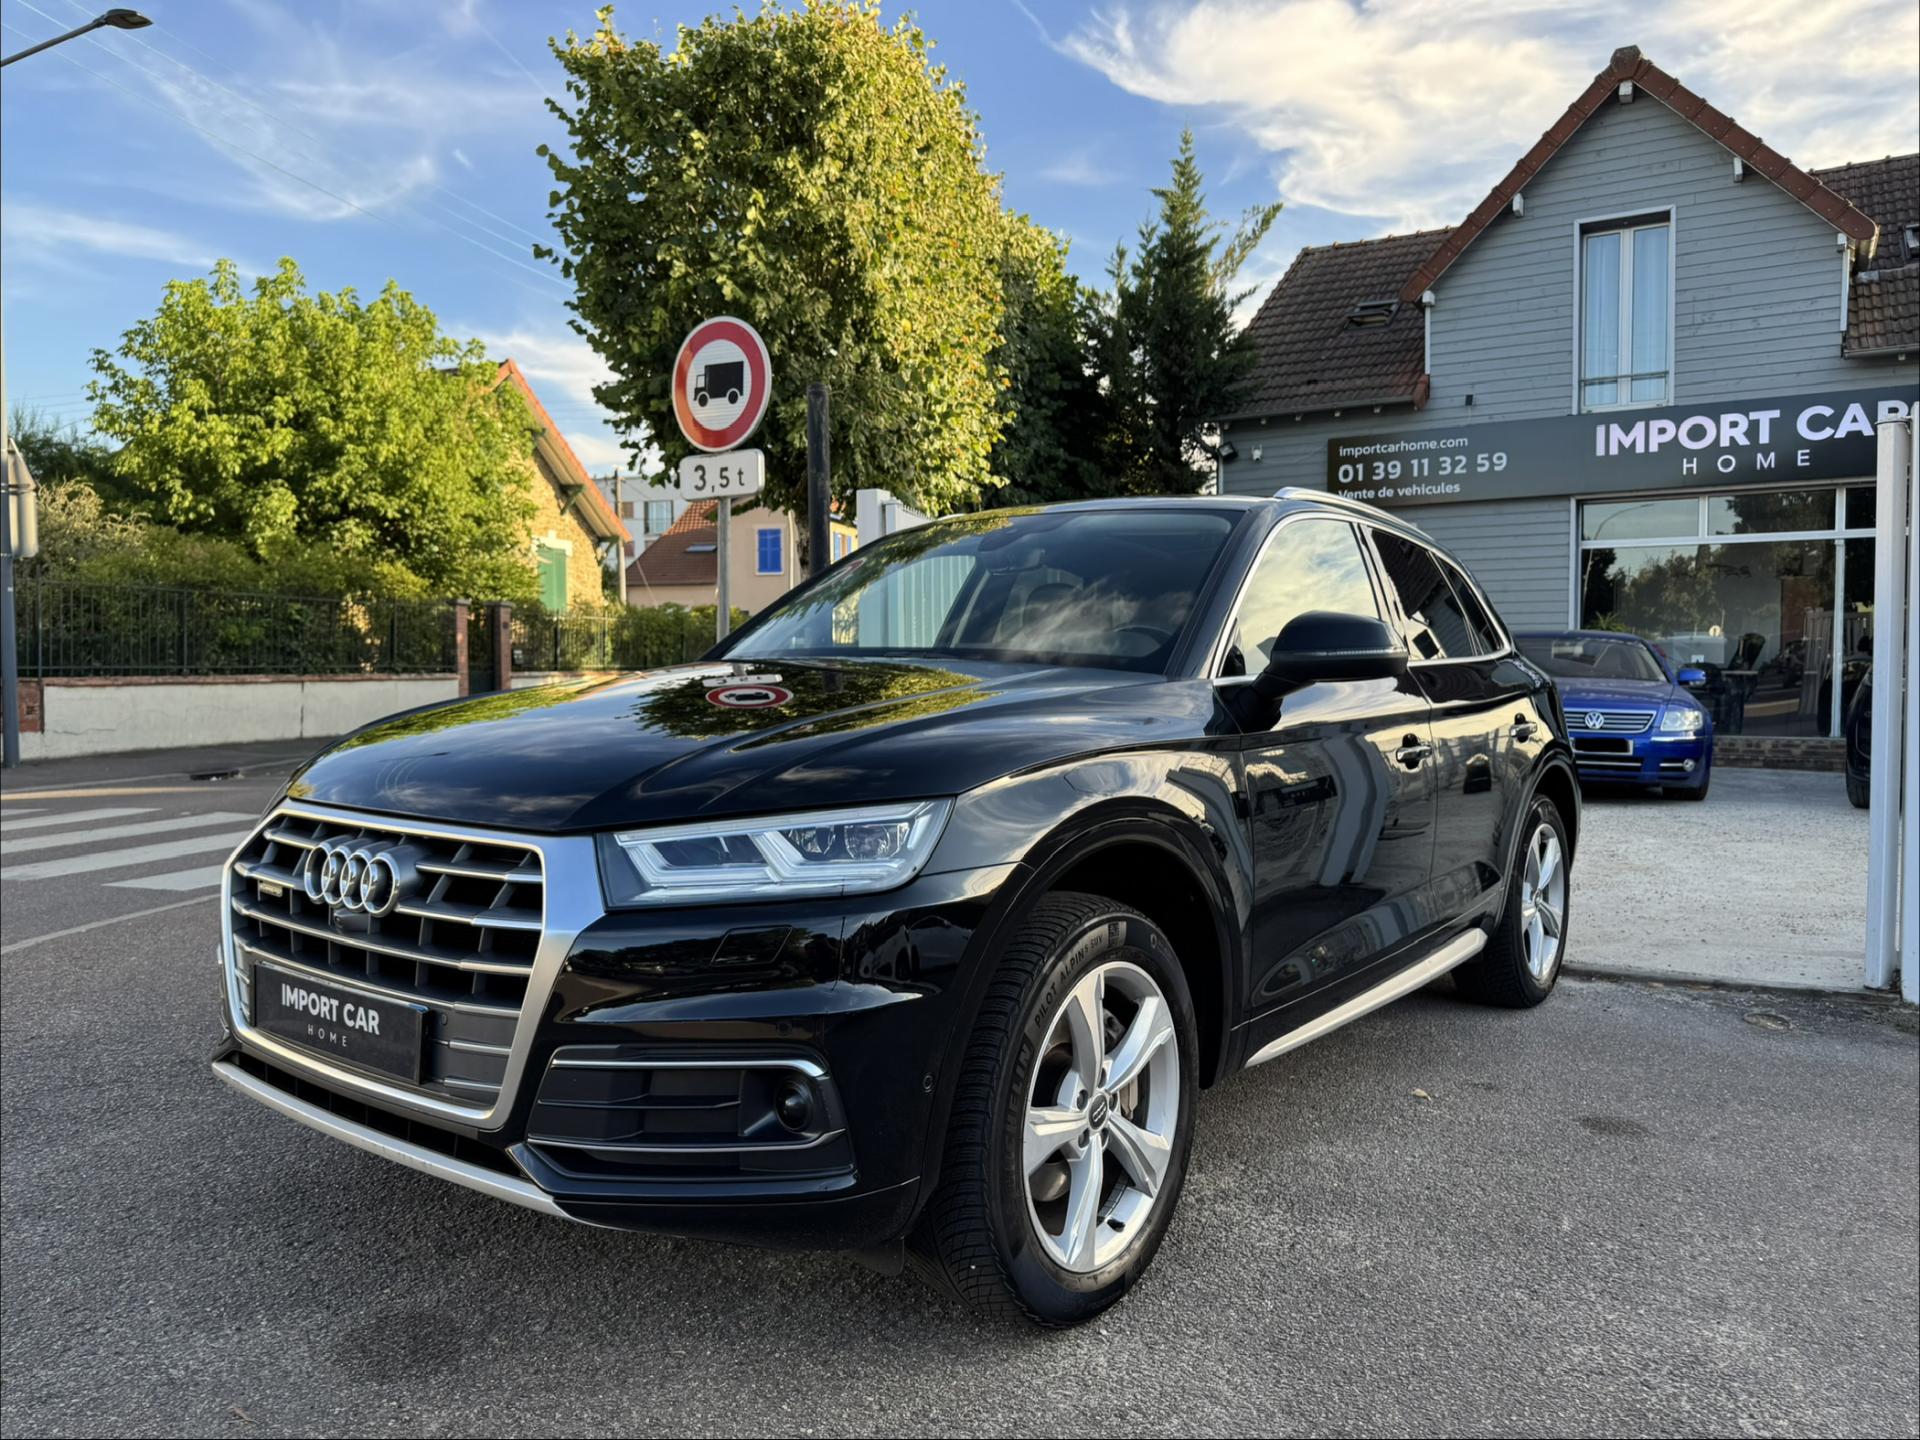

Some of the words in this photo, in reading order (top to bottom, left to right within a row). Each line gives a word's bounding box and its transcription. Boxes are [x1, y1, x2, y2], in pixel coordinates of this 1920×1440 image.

[1595, 409, 1781, 457] IMPORT
[1338, 437, 1469, 459] importcarhome.com
[1682, 449, 1811, 476] HOME
[694, 464, 730, 493] 3,5
[737, 467, 745, 486] t
[1338, 463, 1364, 484] 01
[1372, 460, 1401, 481] 39
[1410, 457, 1430, 477] 11
[1438, 455, 1467, 476] 32
[1476, 452, 1508, 473] 59
[1338, 488, 1375, 500] Vente
[1377, 486, 1394, 498] de
[1396, 482, 1461, 497] vehicules
[281, 983, 340, 1023] IMPORT
[343, 1003, 380, 1036] CAR
[1034, 982, 1057, 1028] PILOT
[307, 1024, 348, 1047] HOME
